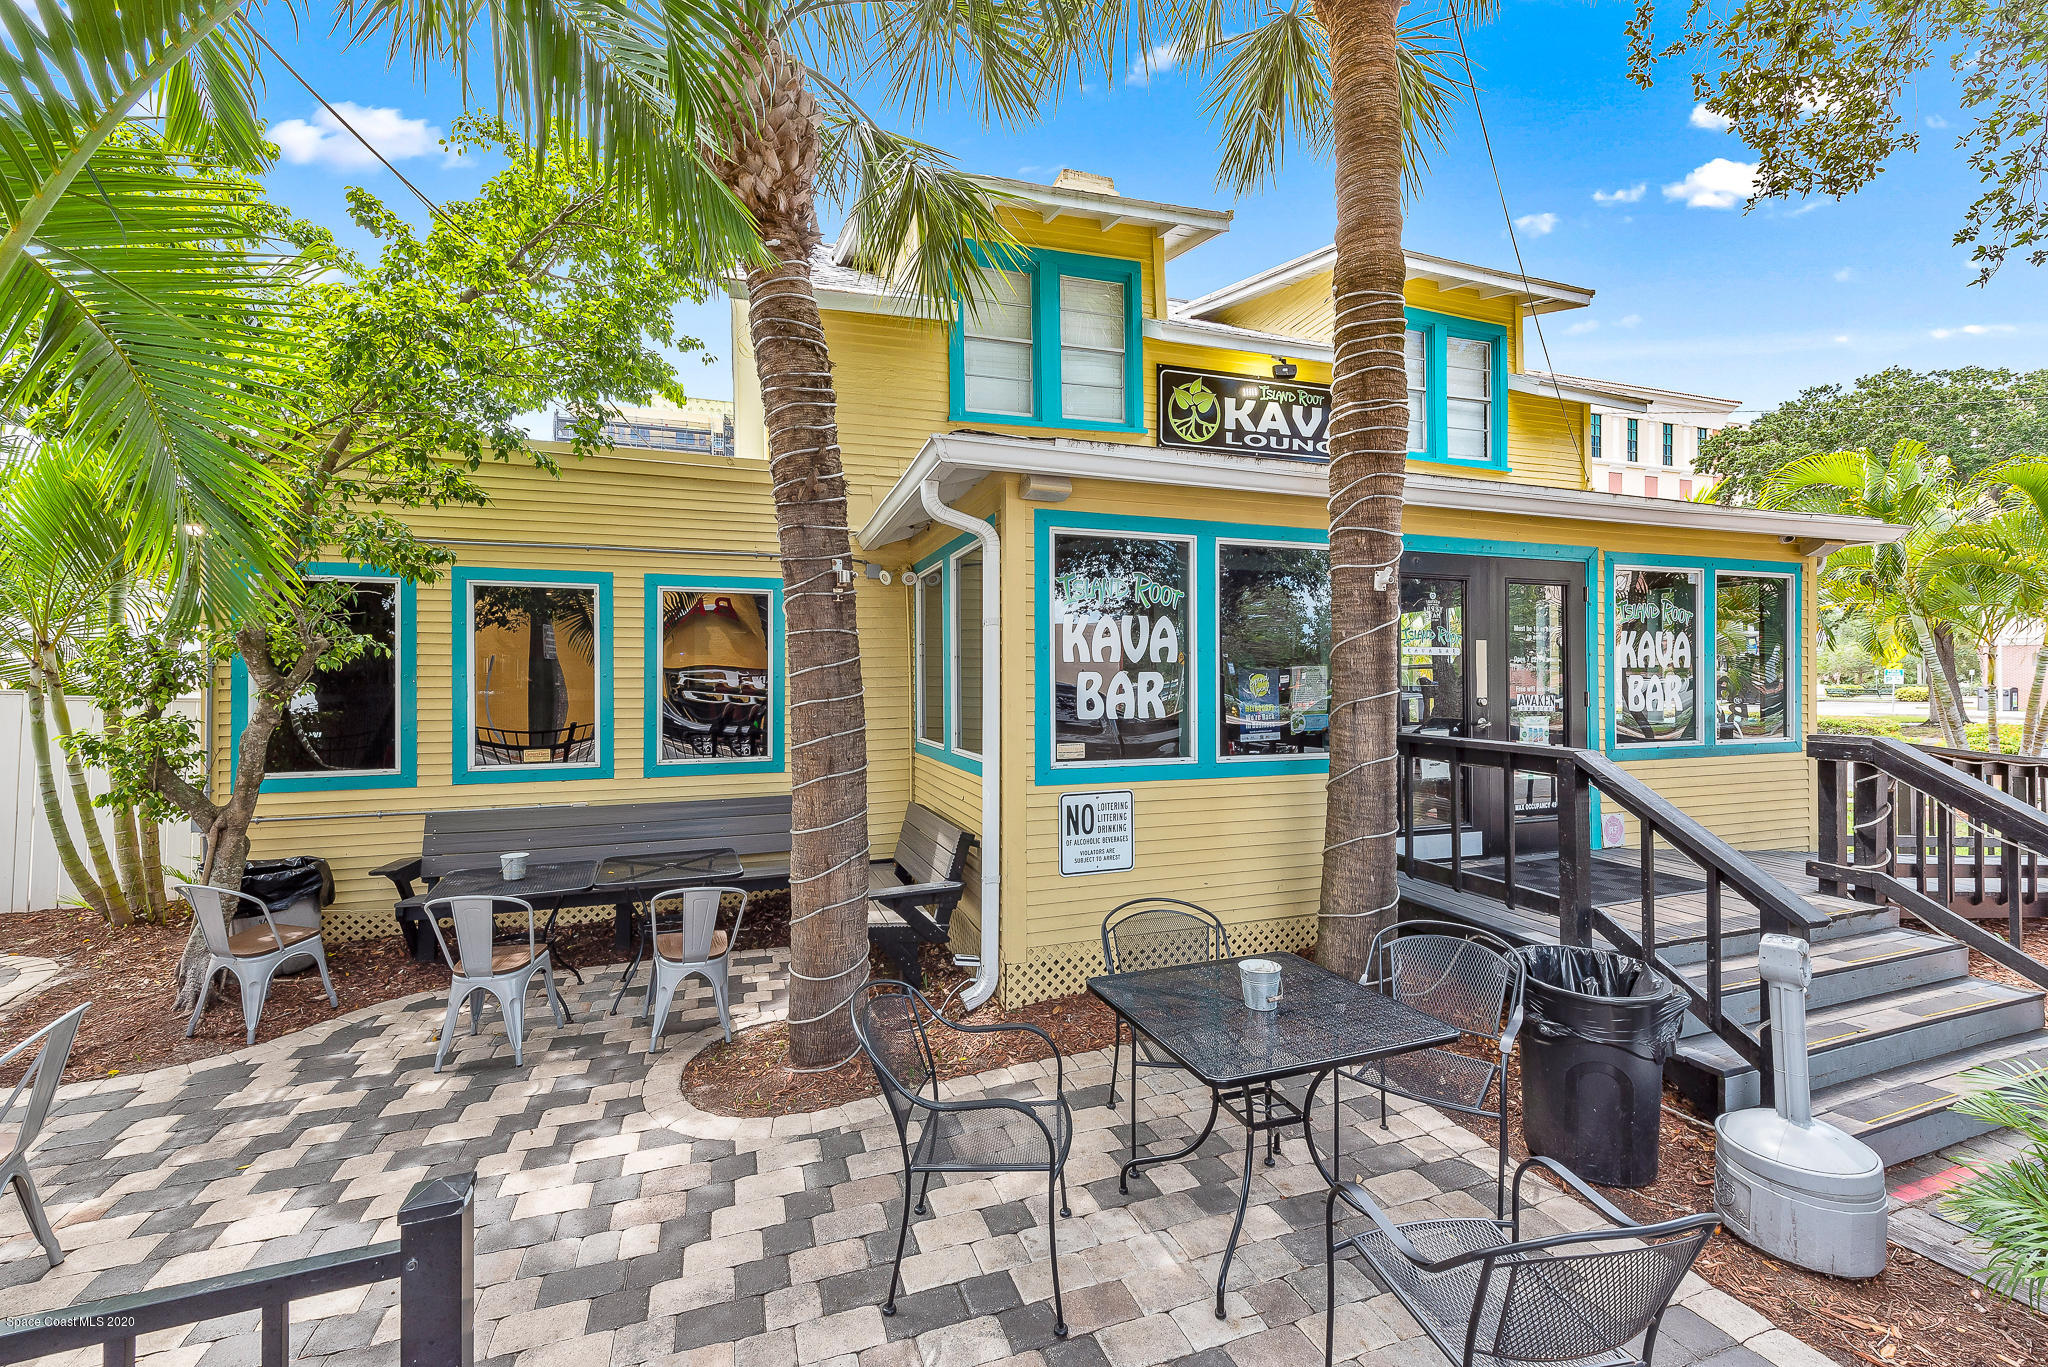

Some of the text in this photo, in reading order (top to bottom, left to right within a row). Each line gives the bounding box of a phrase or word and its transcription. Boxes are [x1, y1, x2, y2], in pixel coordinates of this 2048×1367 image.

[1259, 385, 1325, 406] ISLAND ROOT
[1224, 397, 1329, 439] KAV
[1055, 571, 1185, 610] ISLAND ROOT
[1616, 598, 1694, 626] ISLAND ROOT
[1062, 614, 1178, 663] KAVA
[1401, 626, 1462, 648] ISLAND ROOT
[1620, 630, 1691, 668] KAVA
[1077, 671, 1166, 720] BAR
[1518, 694, 1555, 706] AWAKEN
[1628, 674, 1683, 712] BAR
[1066, 801, 1128, 836] NO LOITERING
[1097, 812, 1128, 823] LITTERING
[1097, 823, 1127, 834] DRINKING
[1073, 837, 1101, 846] ALCOHOLIC
[1102, 835, 1129, 844] BEVERAGES
[1079, 848, 1105, 856] VIOLATORS
[1074, 856, 1095, 864] SUBJECT
